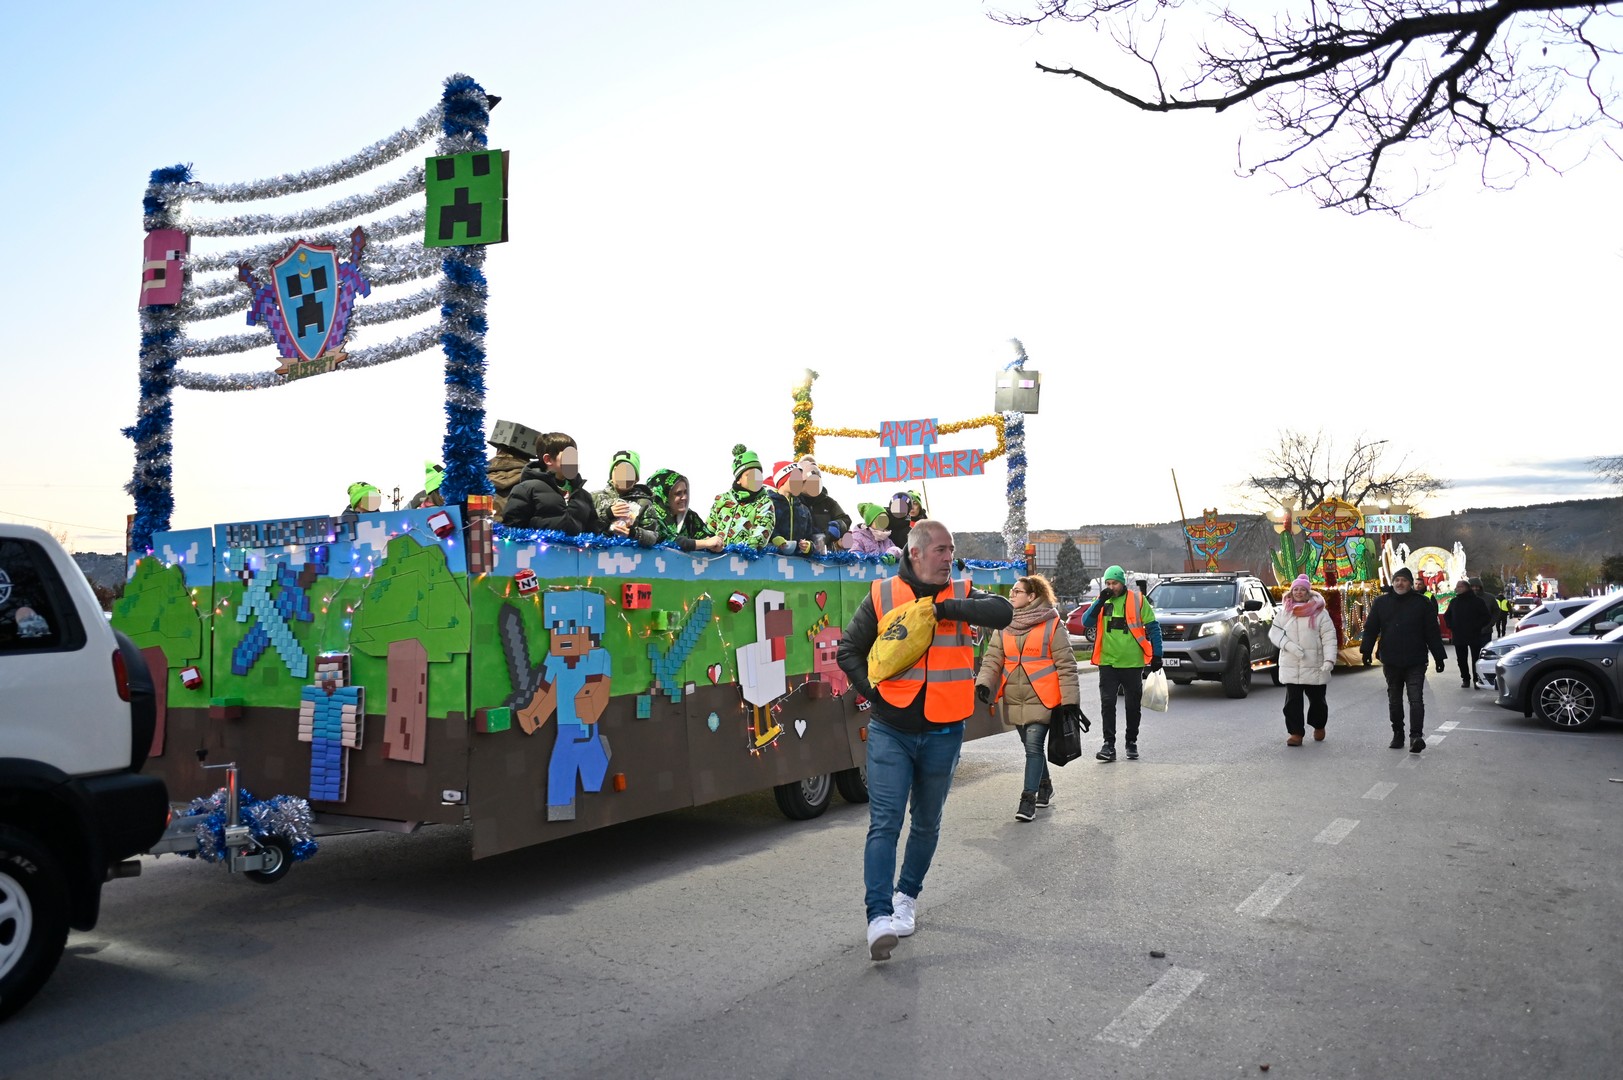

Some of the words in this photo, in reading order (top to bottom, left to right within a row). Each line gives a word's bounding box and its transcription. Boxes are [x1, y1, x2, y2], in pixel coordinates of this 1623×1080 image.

[880, 418, 937, 447] AMPA
[856, 449, 985, 484] VALDEMERA
[625, 584, 634, 607] TNT
[637, 590, 651, 600] TNT
[1166, 659, 1179, 667] LCM
